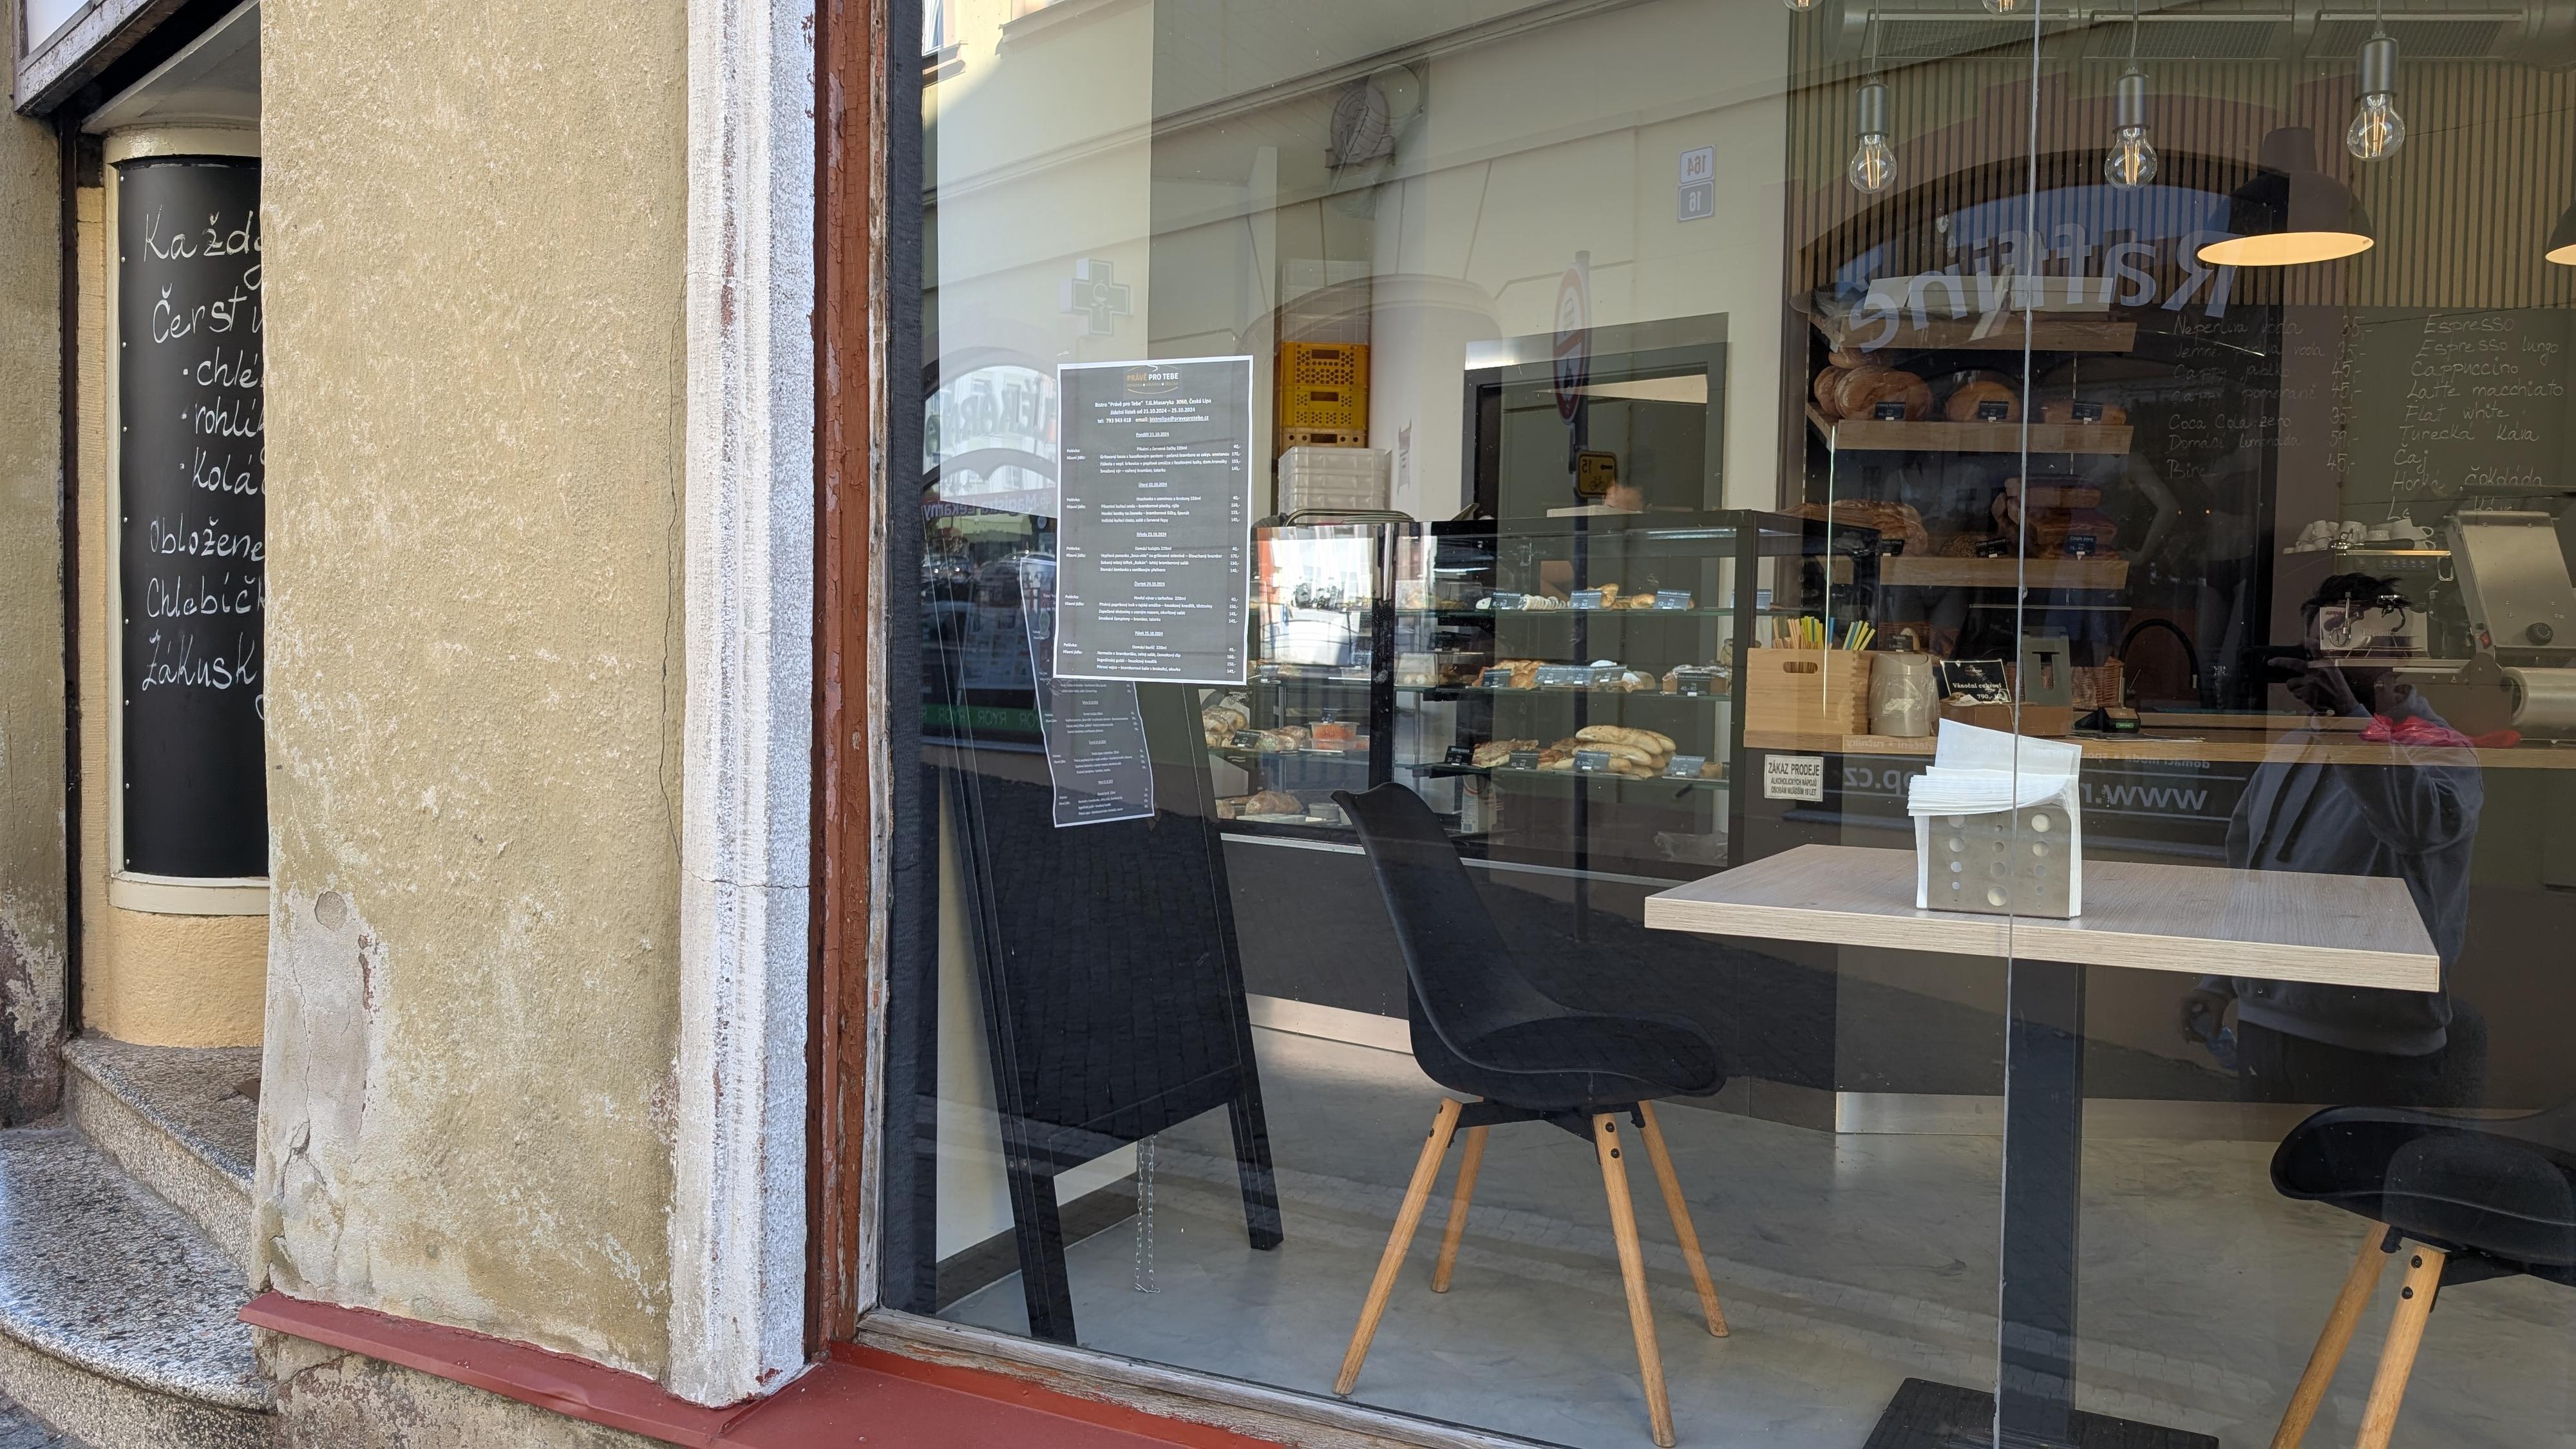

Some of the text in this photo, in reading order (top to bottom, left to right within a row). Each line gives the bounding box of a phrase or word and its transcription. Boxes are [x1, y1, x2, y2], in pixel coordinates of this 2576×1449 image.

[2423, 314, 2515, 345] Espresso
[2416, 338, 2508, 361] Espresso
[197, 346, 264, 388] chlé
[1127, 373, 1148, 381] PRÁVĚ
[2411, 355, 2519, 384] Cappuccino
[2406, 377, 2564, 400] Latte macchiato
[2168, 413, 2206, 430] Coca
[2405, 399, 2510, 422] Flat white
[2393, 442, 2429, 475] Čaj
[1768, 760, 1820, 777] ZÁKAZ PRODEJE
[1771, 777, 1802, 786] ALKOHOLICKÝCH
[1771, 786, 1787, 794] OSOBÁM
